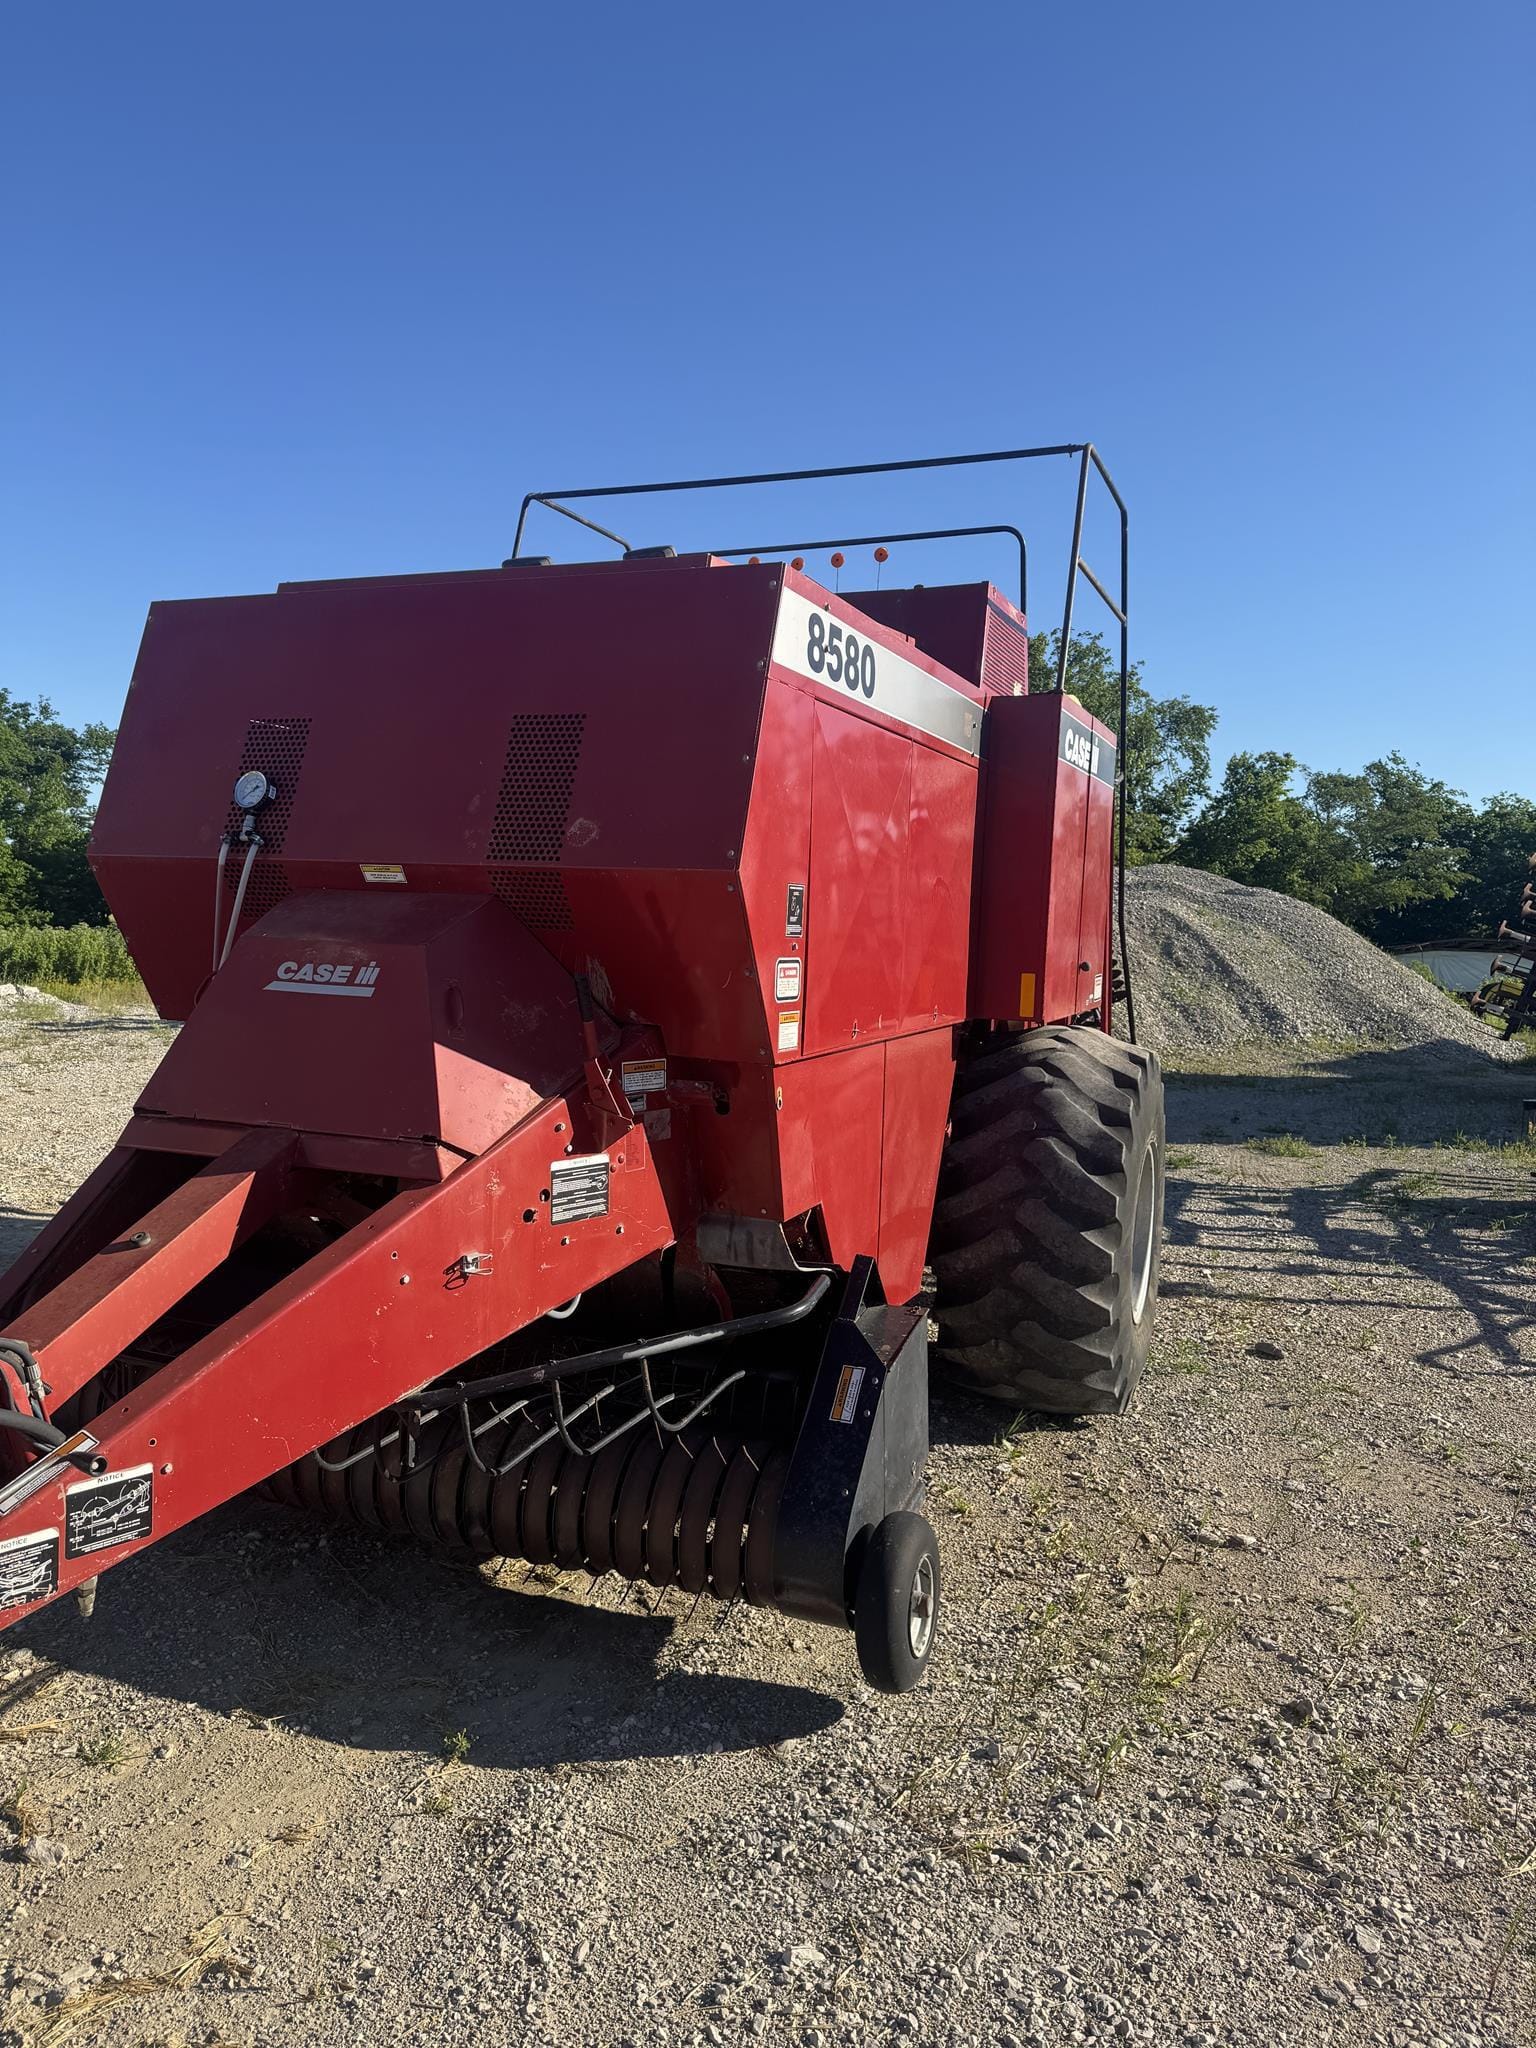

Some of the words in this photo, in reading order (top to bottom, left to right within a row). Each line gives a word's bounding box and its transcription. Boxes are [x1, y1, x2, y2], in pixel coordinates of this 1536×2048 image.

[807, 612, 876, 699] 8580
[1064, 728, 1092, 772] CASE
[277, 961, 353, 983] CASE
[97, 1473, 124, 1484] NOTICE
[0, 1538, 28, 1550] NOTICE
